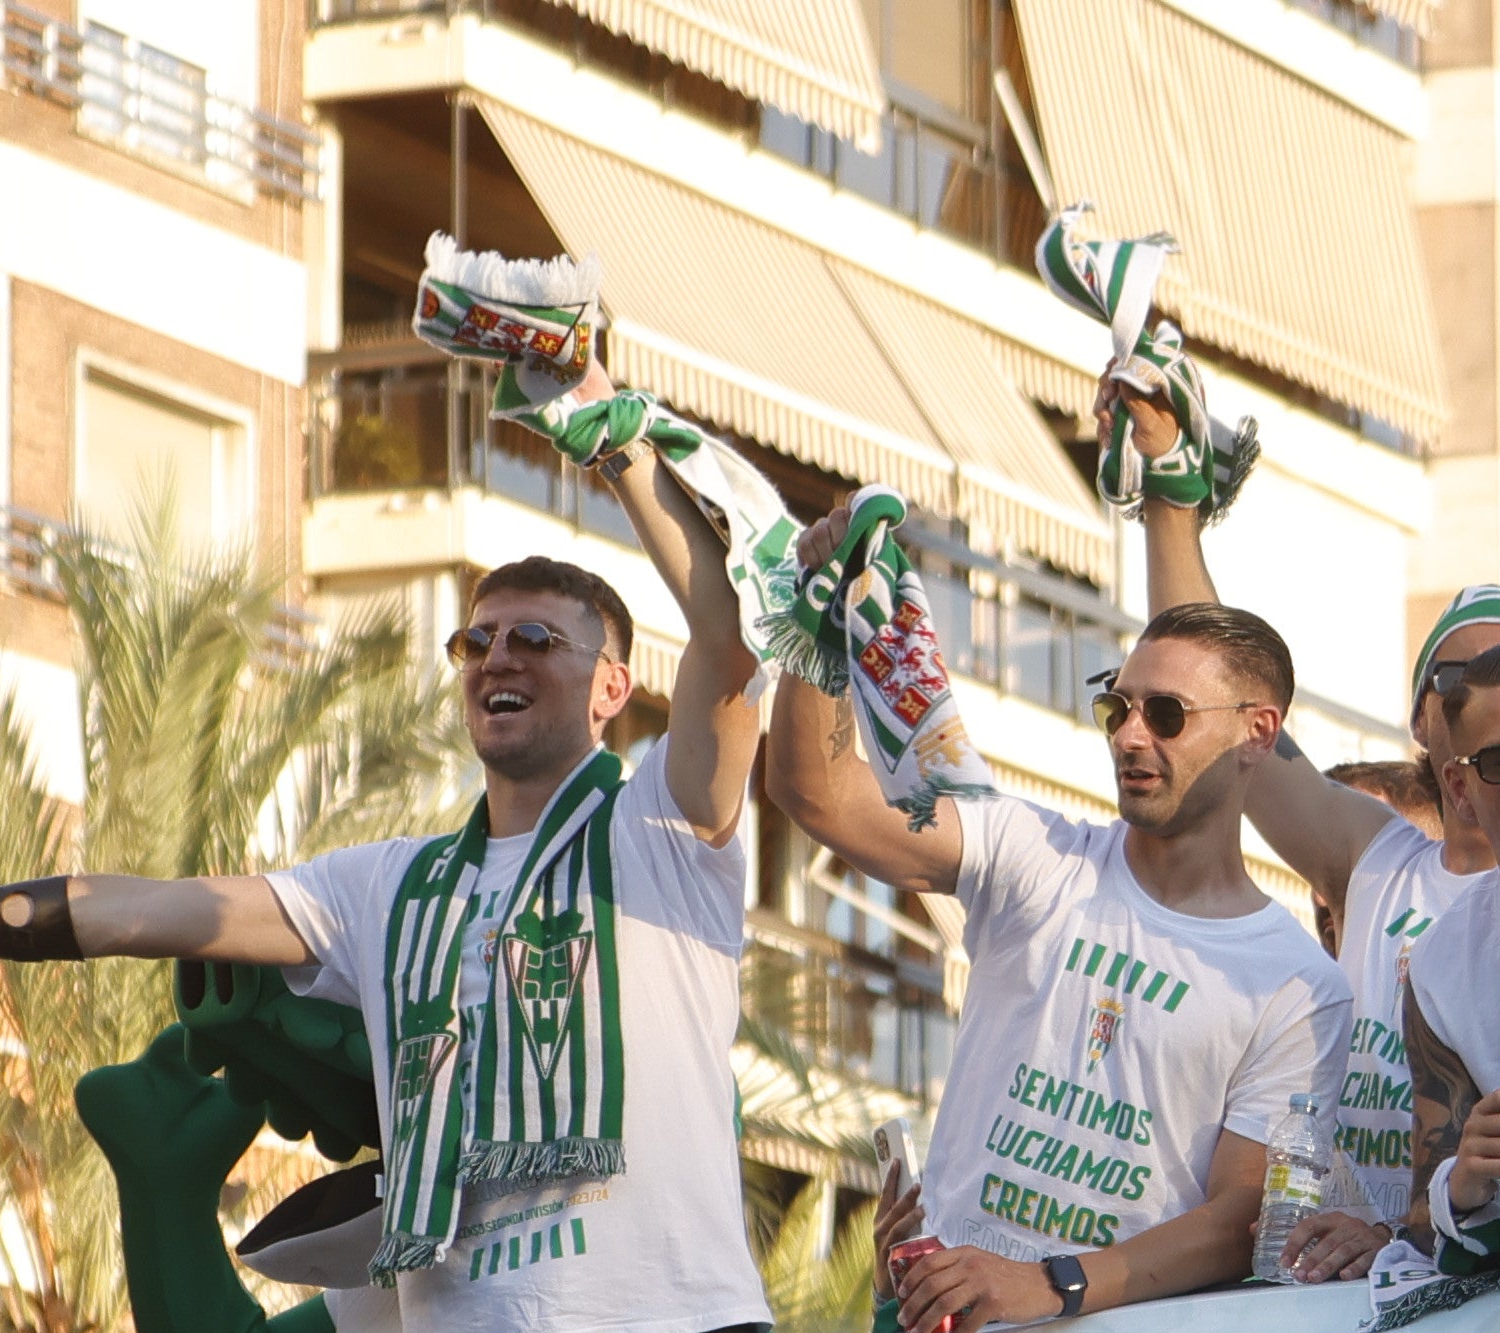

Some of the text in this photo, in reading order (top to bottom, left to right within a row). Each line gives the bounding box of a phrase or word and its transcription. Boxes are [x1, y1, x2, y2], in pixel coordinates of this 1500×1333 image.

[1008, 1062, 1153, 1147] SENTIMOS
[985, 1114, 1152, 1201] LUCHAMOS
[979, 1173, 1119, 1248] CREIMOS
